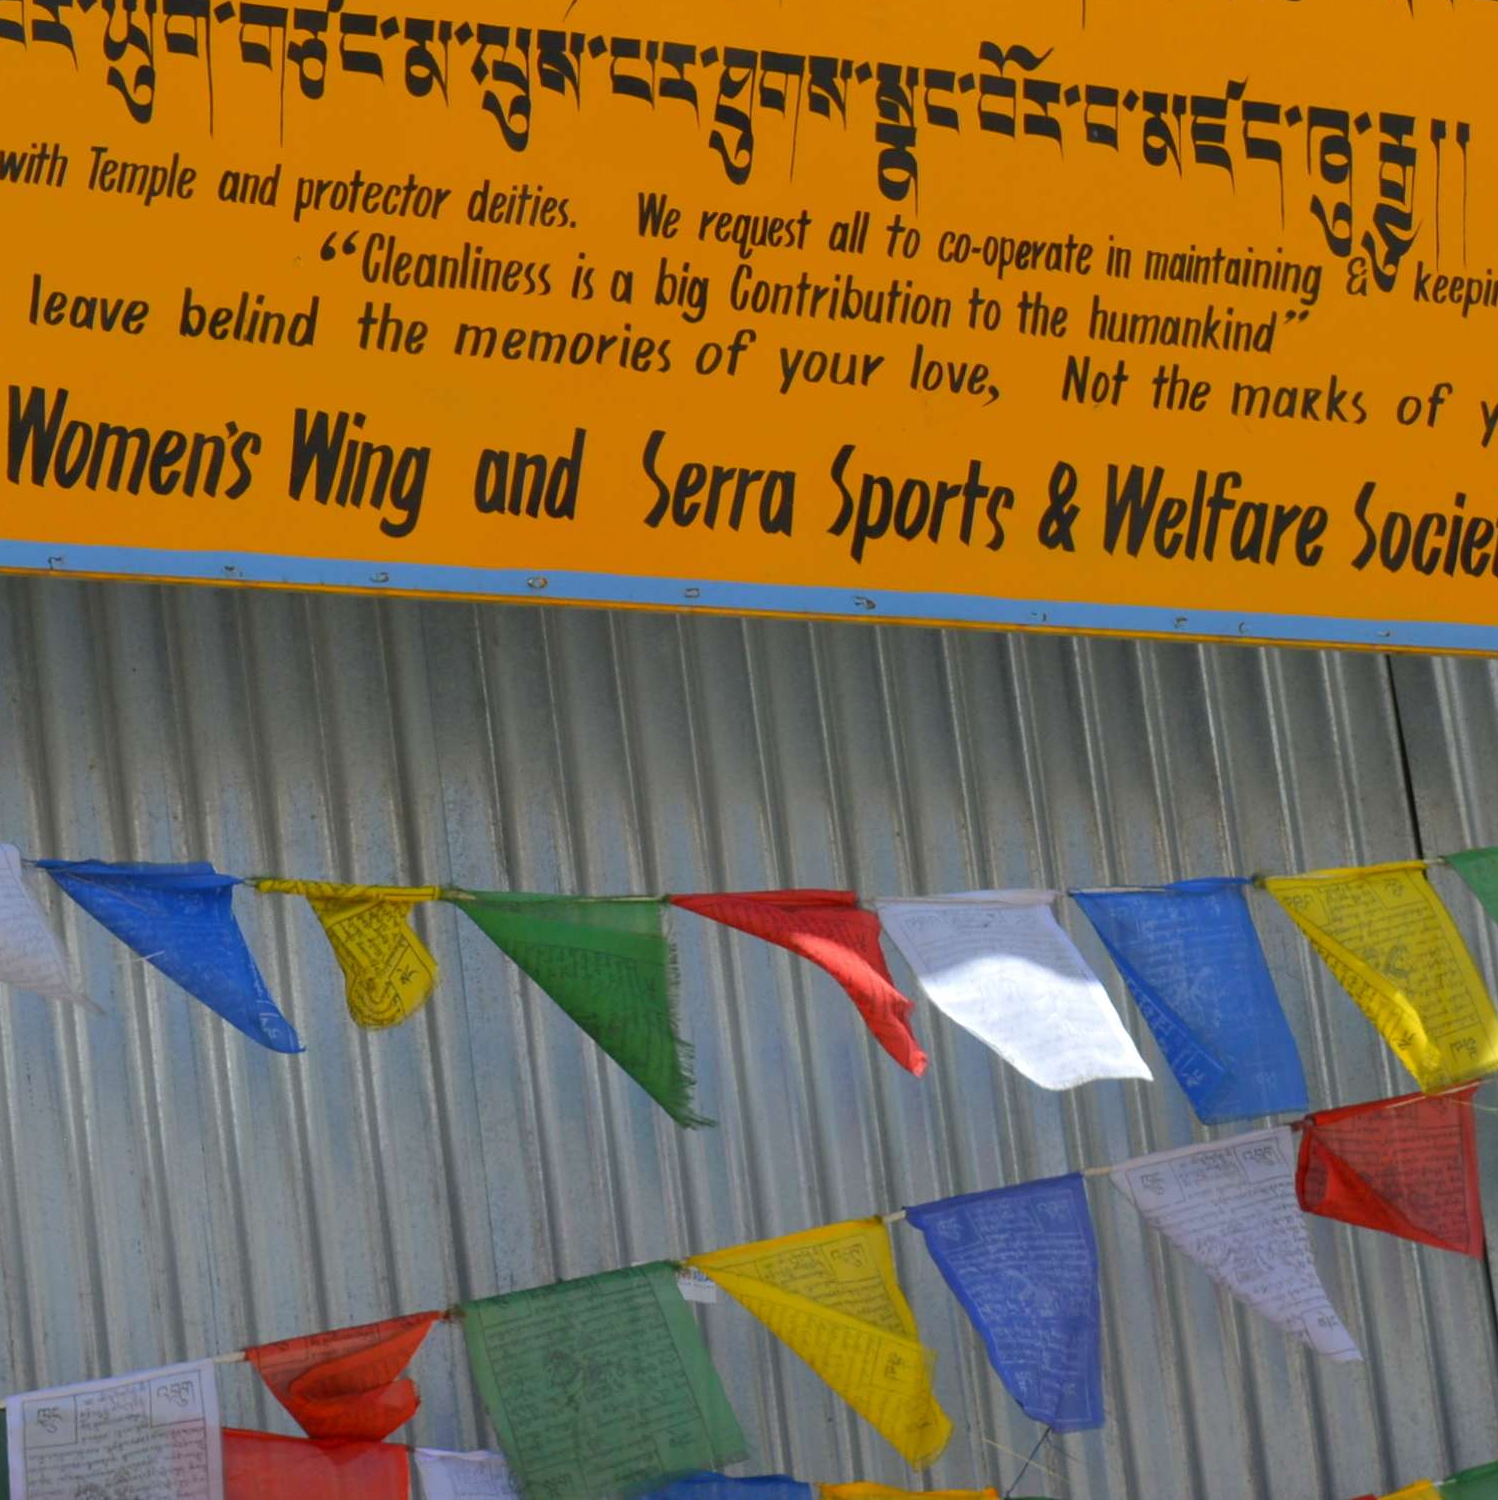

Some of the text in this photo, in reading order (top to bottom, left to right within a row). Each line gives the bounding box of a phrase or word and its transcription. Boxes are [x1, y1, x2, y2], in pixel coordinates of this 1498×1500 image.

[89, 147, 196, 206] Temple
[219, 164, 281, 206] and
[294, 170, 451, 222] protector
[468, 180, 576, 228] deities.
[639, 193, 680, 238] We
[699, 211, 812, 259] request
[829, 211, 869, 253] all
[887, 215, 920, 258] to
[939, 232, 1093, 279] co-operate
[1107, 236, 1131, 278] in
[1145, 245, 1322, 306] maintaining
[1347, 257, 1367, 296] &
[572, 253, 594, 299] is
[611, 271, 633, 303] a
[655, 258, 709, 323] big
[731, 264, 951, 327] Contribution
[969, 288, 1001, 330] to
[1018, 292, 1067, 337] the
[30, 274, 149, 334] leave
[358, 302, 427, 354] the
[455, 324, 670, 372] memories
[696, 329, 756, 375] of
[780, 348, 884, 394] your
[911, 344, 999, 404] love,
[1062, 356, 1128, 405] Not
[1153, 364, 1211, 411] the
[1232, 375, 1366, 424] marks
[1397, 383, 1453, 426] of
[289, 408, 431, 538] Wing
[475, 428, 586, 520] and
[643, 430, 796, 537] Serra
[827, 445, 1014, 564] Sports
[1038, 461, 1080, 552] &
[1104, 464, 1328, 567] Welfare
